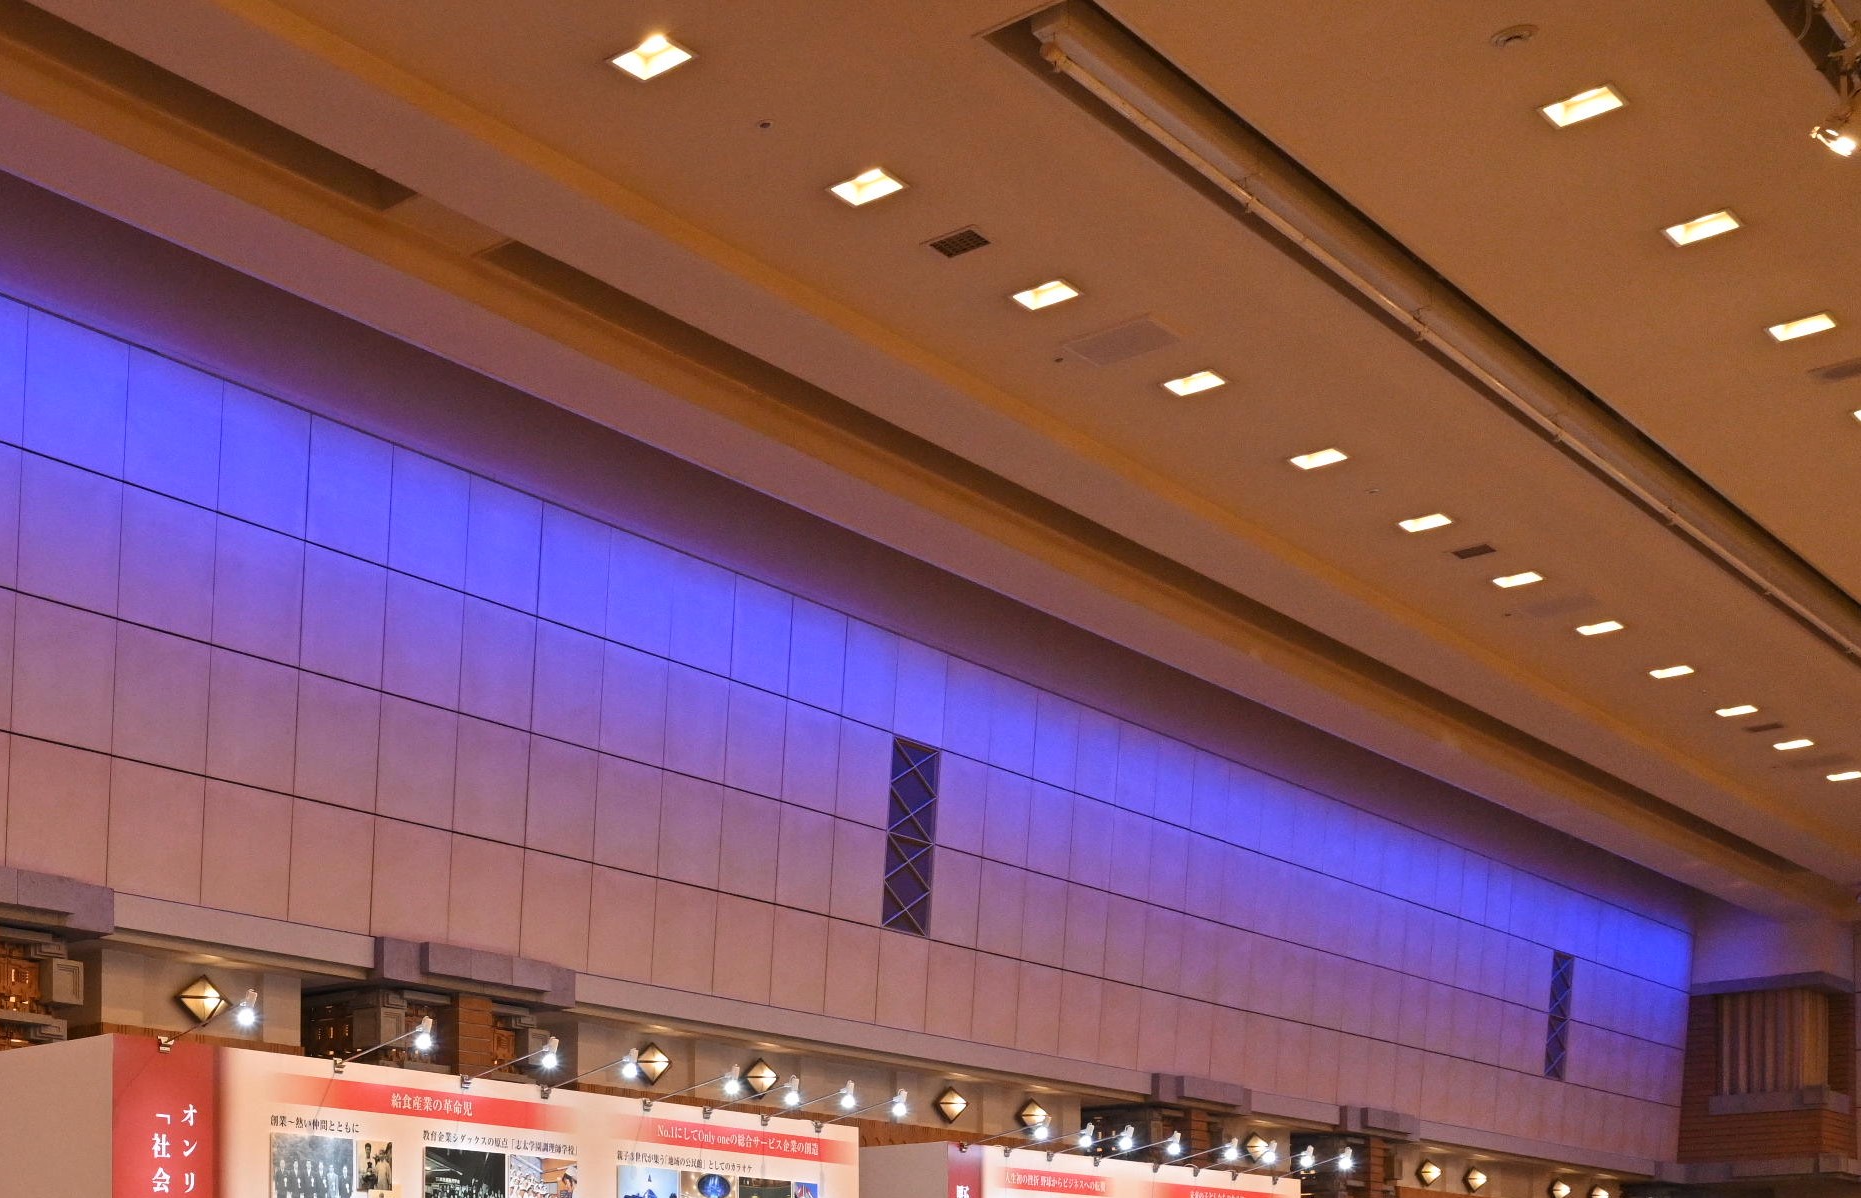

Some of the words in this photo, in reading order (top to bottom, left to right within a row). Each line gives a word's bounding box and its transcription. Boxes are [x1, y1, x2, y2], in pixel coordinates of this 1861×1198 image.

[391, 1093, 473, 1117] 給食産業の革命児
